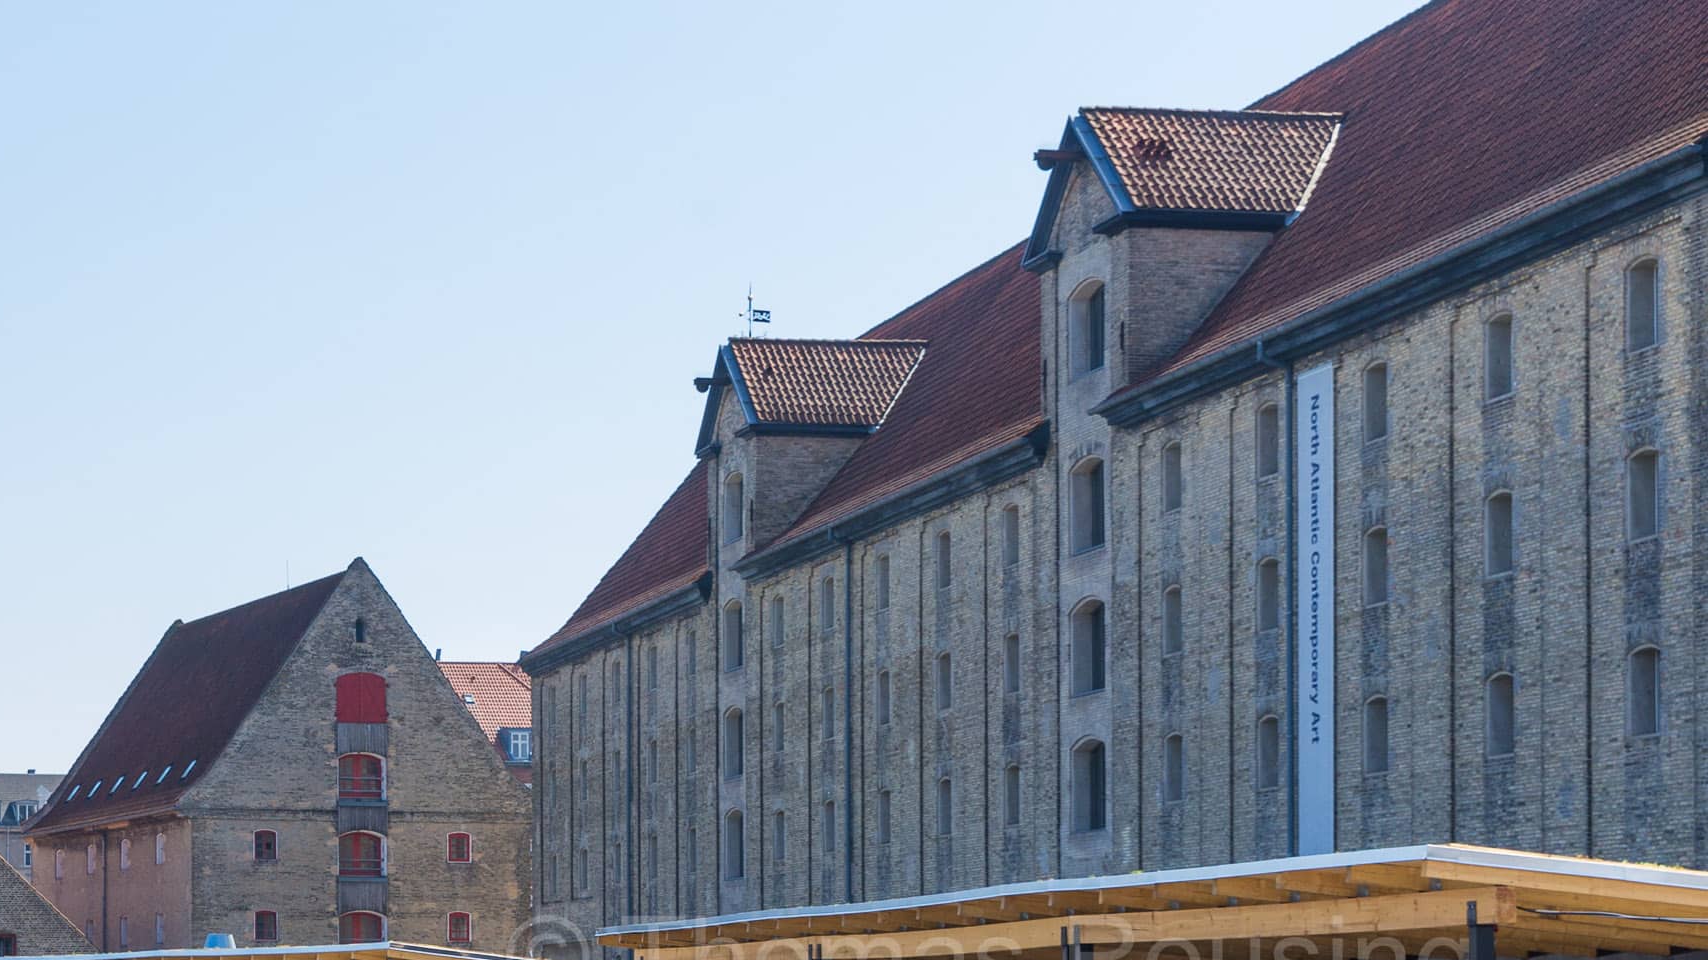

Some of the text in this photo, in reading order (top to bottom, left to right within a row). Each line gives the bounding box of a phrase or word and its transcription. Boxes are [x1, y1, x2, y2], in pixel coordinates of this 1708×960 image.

[1309, 394, 1321, 744] North Atlantic Contemporary Art
